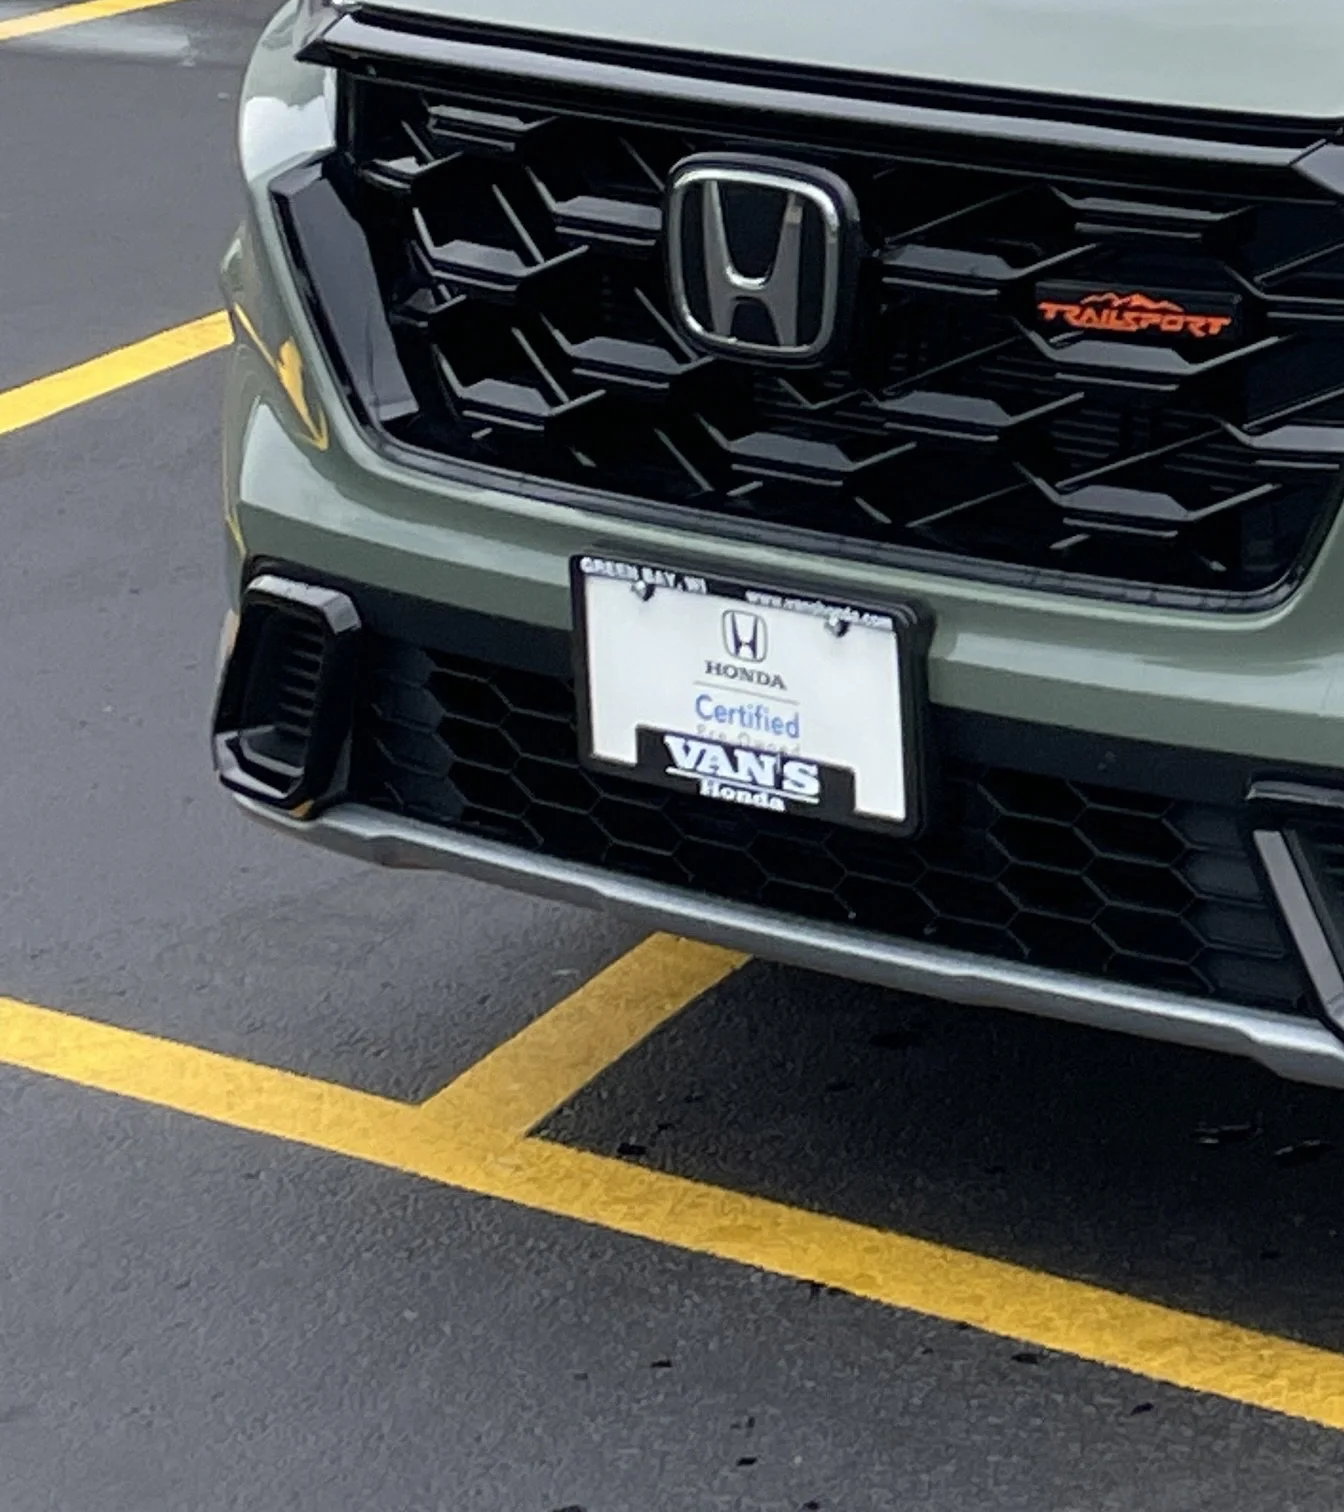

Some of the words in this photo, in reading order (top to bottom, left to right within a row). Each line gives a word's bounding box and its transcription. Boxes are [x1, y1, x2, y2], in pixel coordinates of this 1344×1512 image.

[1037, 301, 1232, 338] TRAILSPORT
[704, 659, 788, 691] HONDA
[695, 693, 800, 739] Certified
[664, 734, 821, 796] VAN'S
[700, 776, 786, 813] Honda
